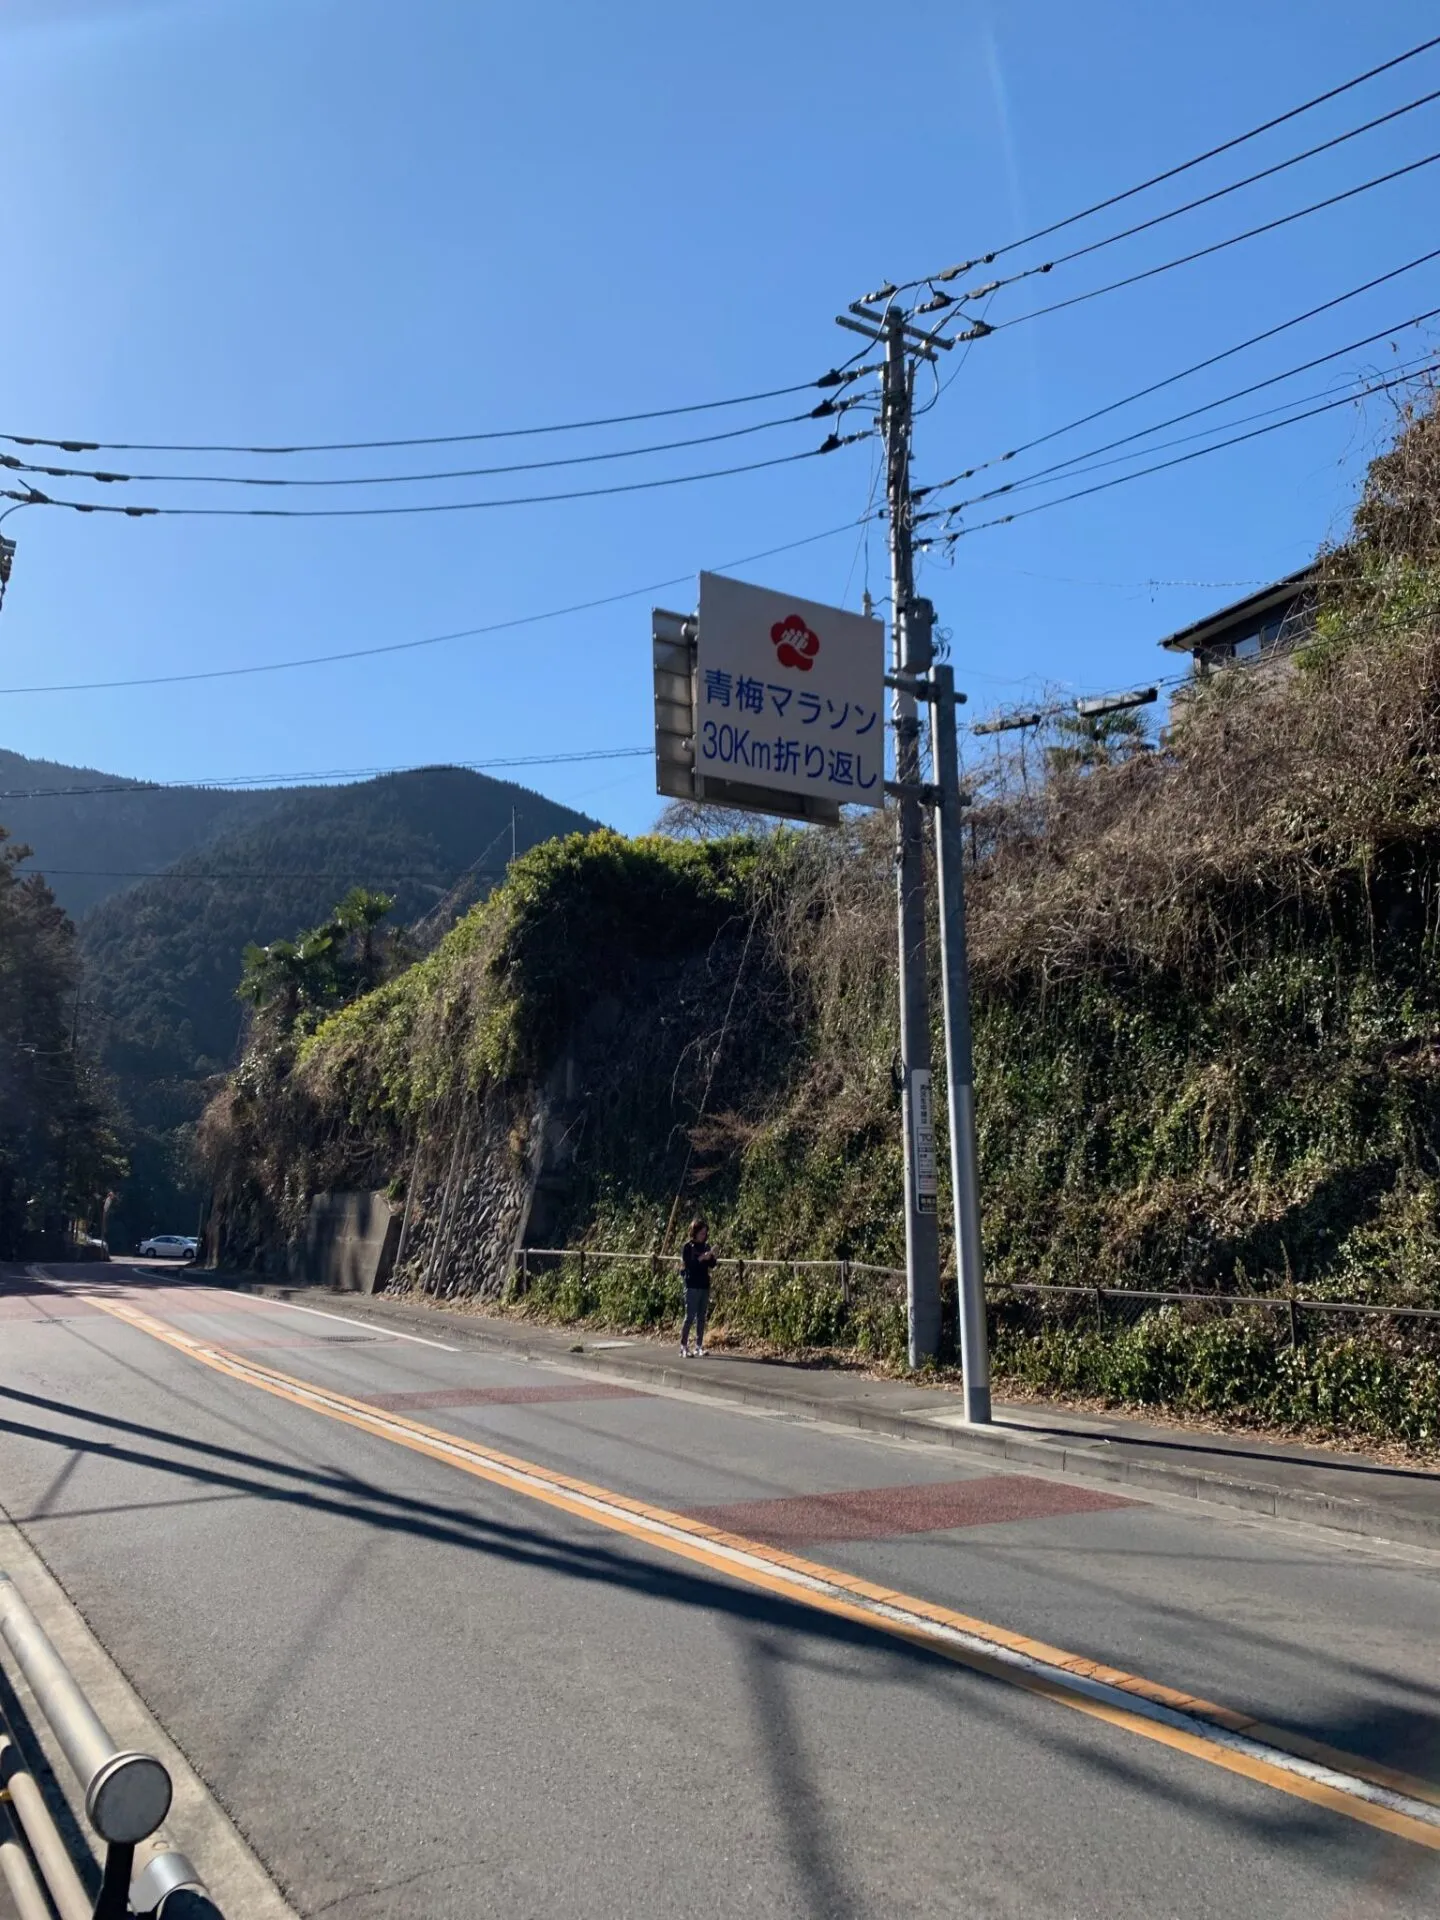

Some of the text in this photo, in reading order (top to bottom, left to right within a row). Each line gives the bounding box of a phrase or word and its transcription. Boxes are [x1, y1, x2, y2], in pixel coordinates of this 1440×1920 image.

[705, 669, 877, 735] 青梅マラソン
[703, 720, 877, 789] 30Km折り返し
